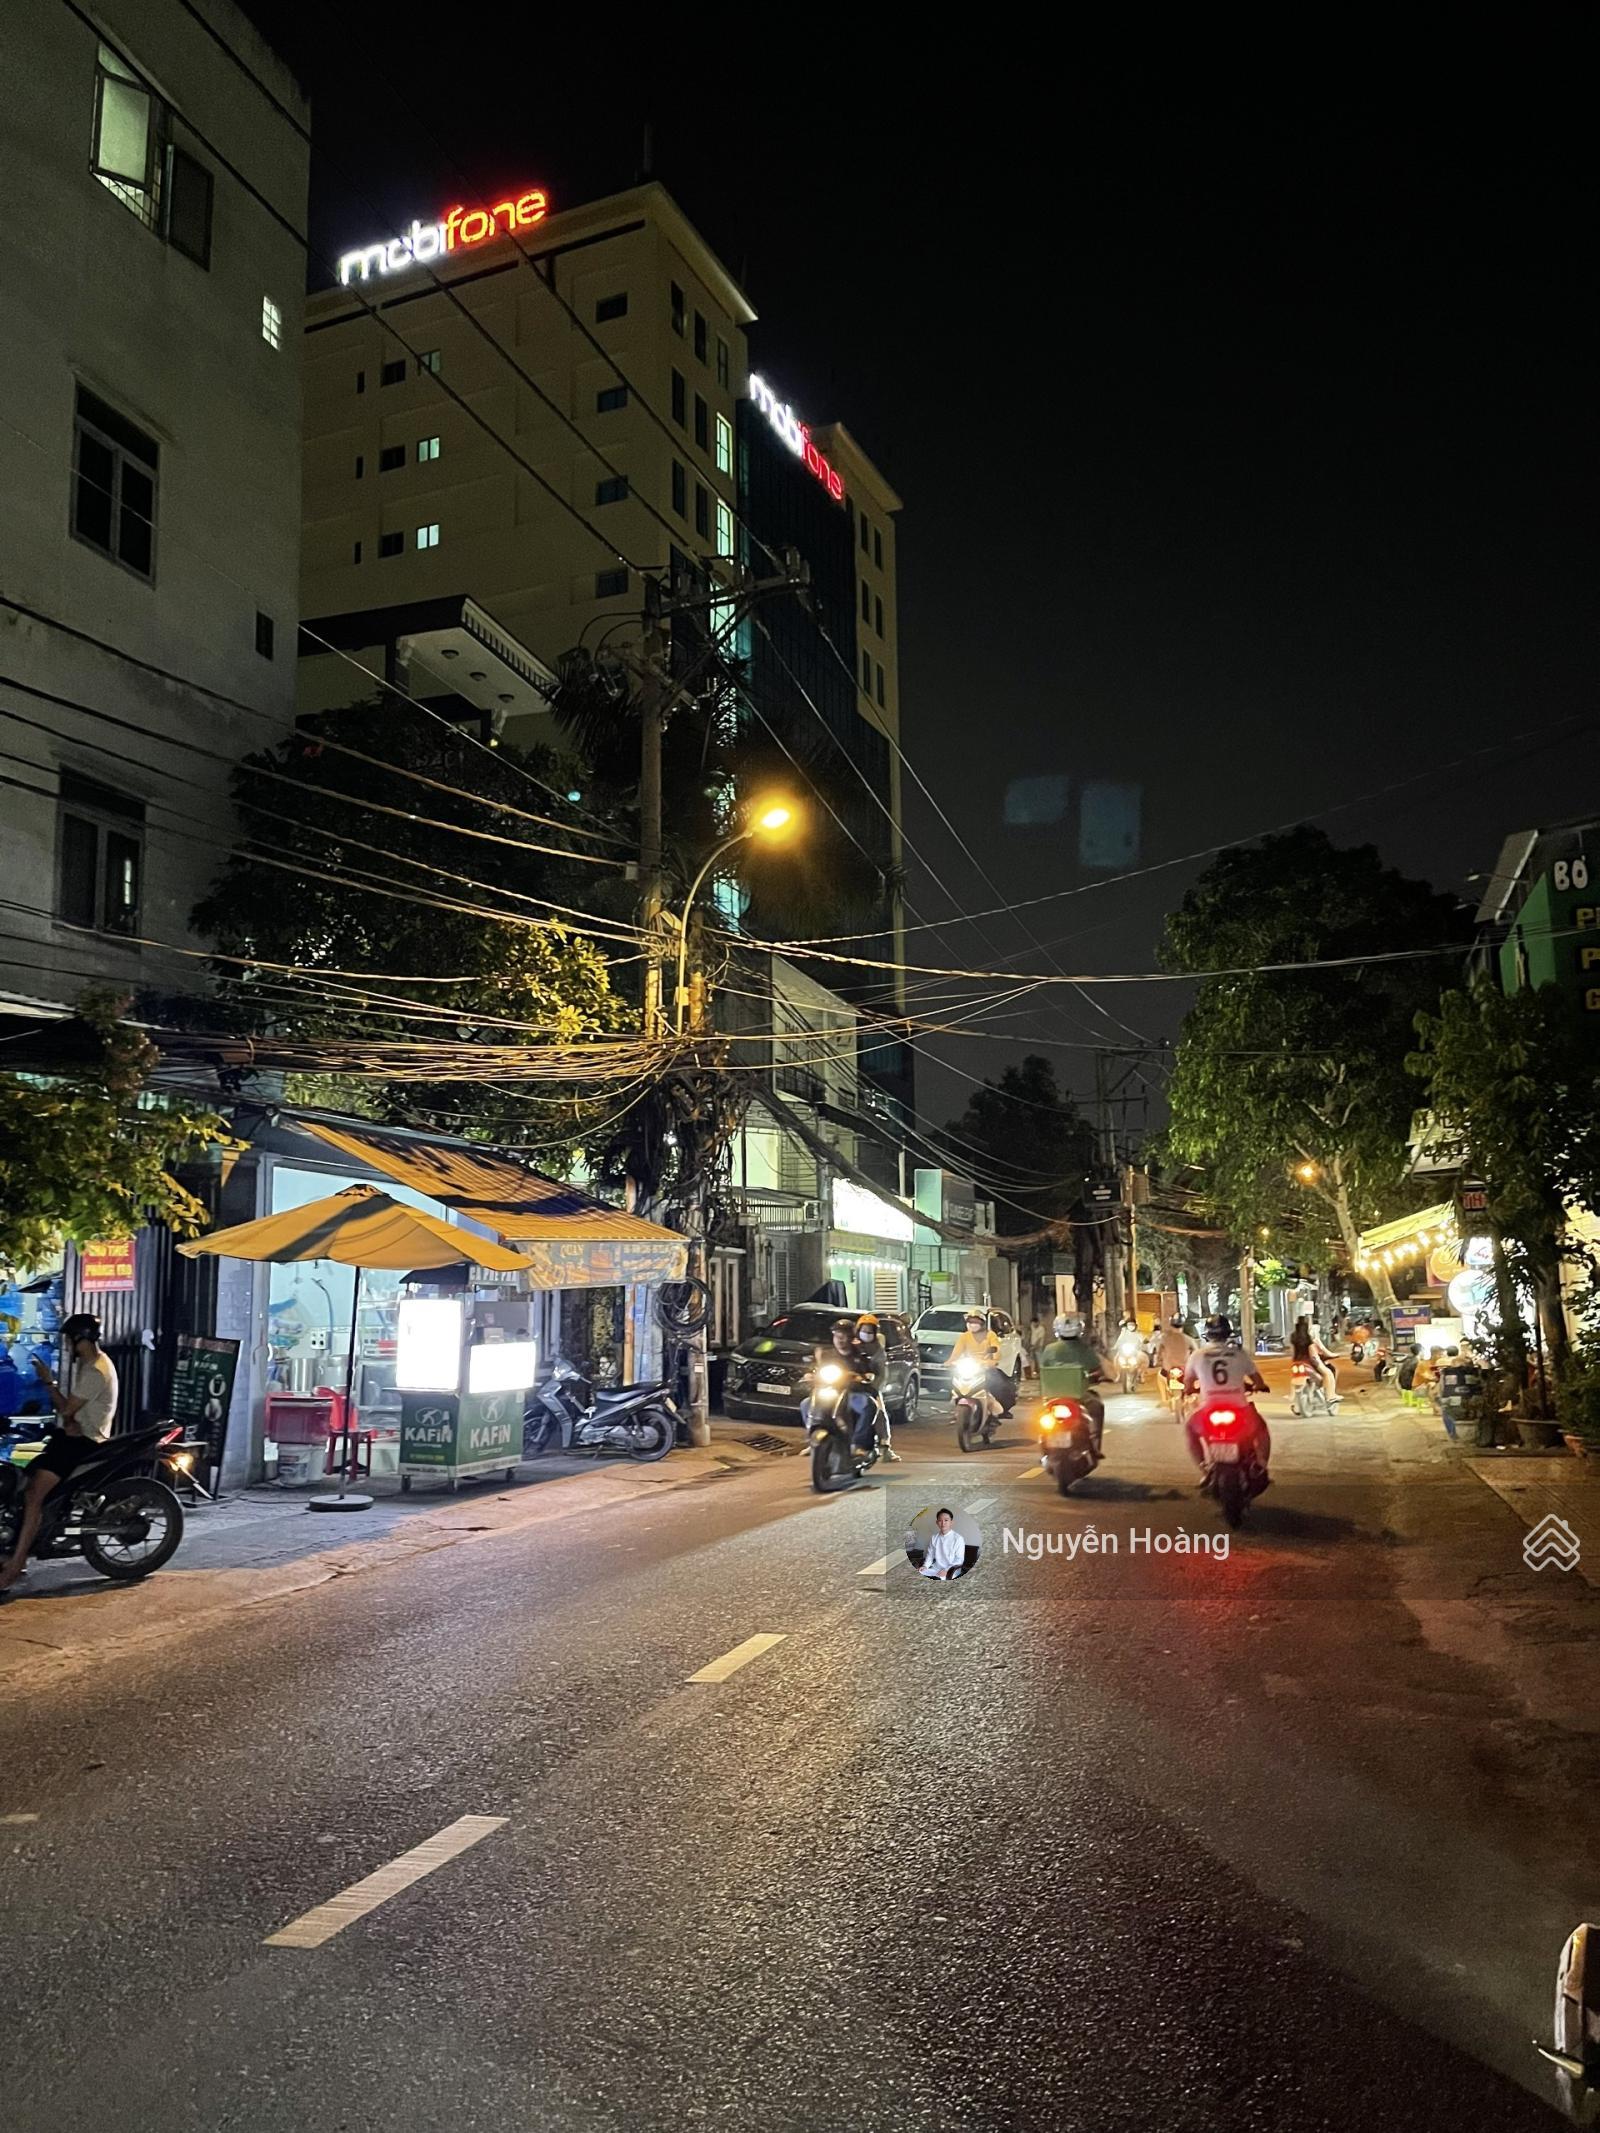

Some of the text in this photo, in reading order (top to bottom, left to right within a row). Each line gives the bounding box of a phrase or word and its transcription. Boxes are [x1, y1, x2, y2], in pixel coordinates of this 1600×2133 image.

[338, 192, 546, 286] mobifone
[749, 373, 842, 500] mobifone
[1211, 1359, 1229, 1386] 6
